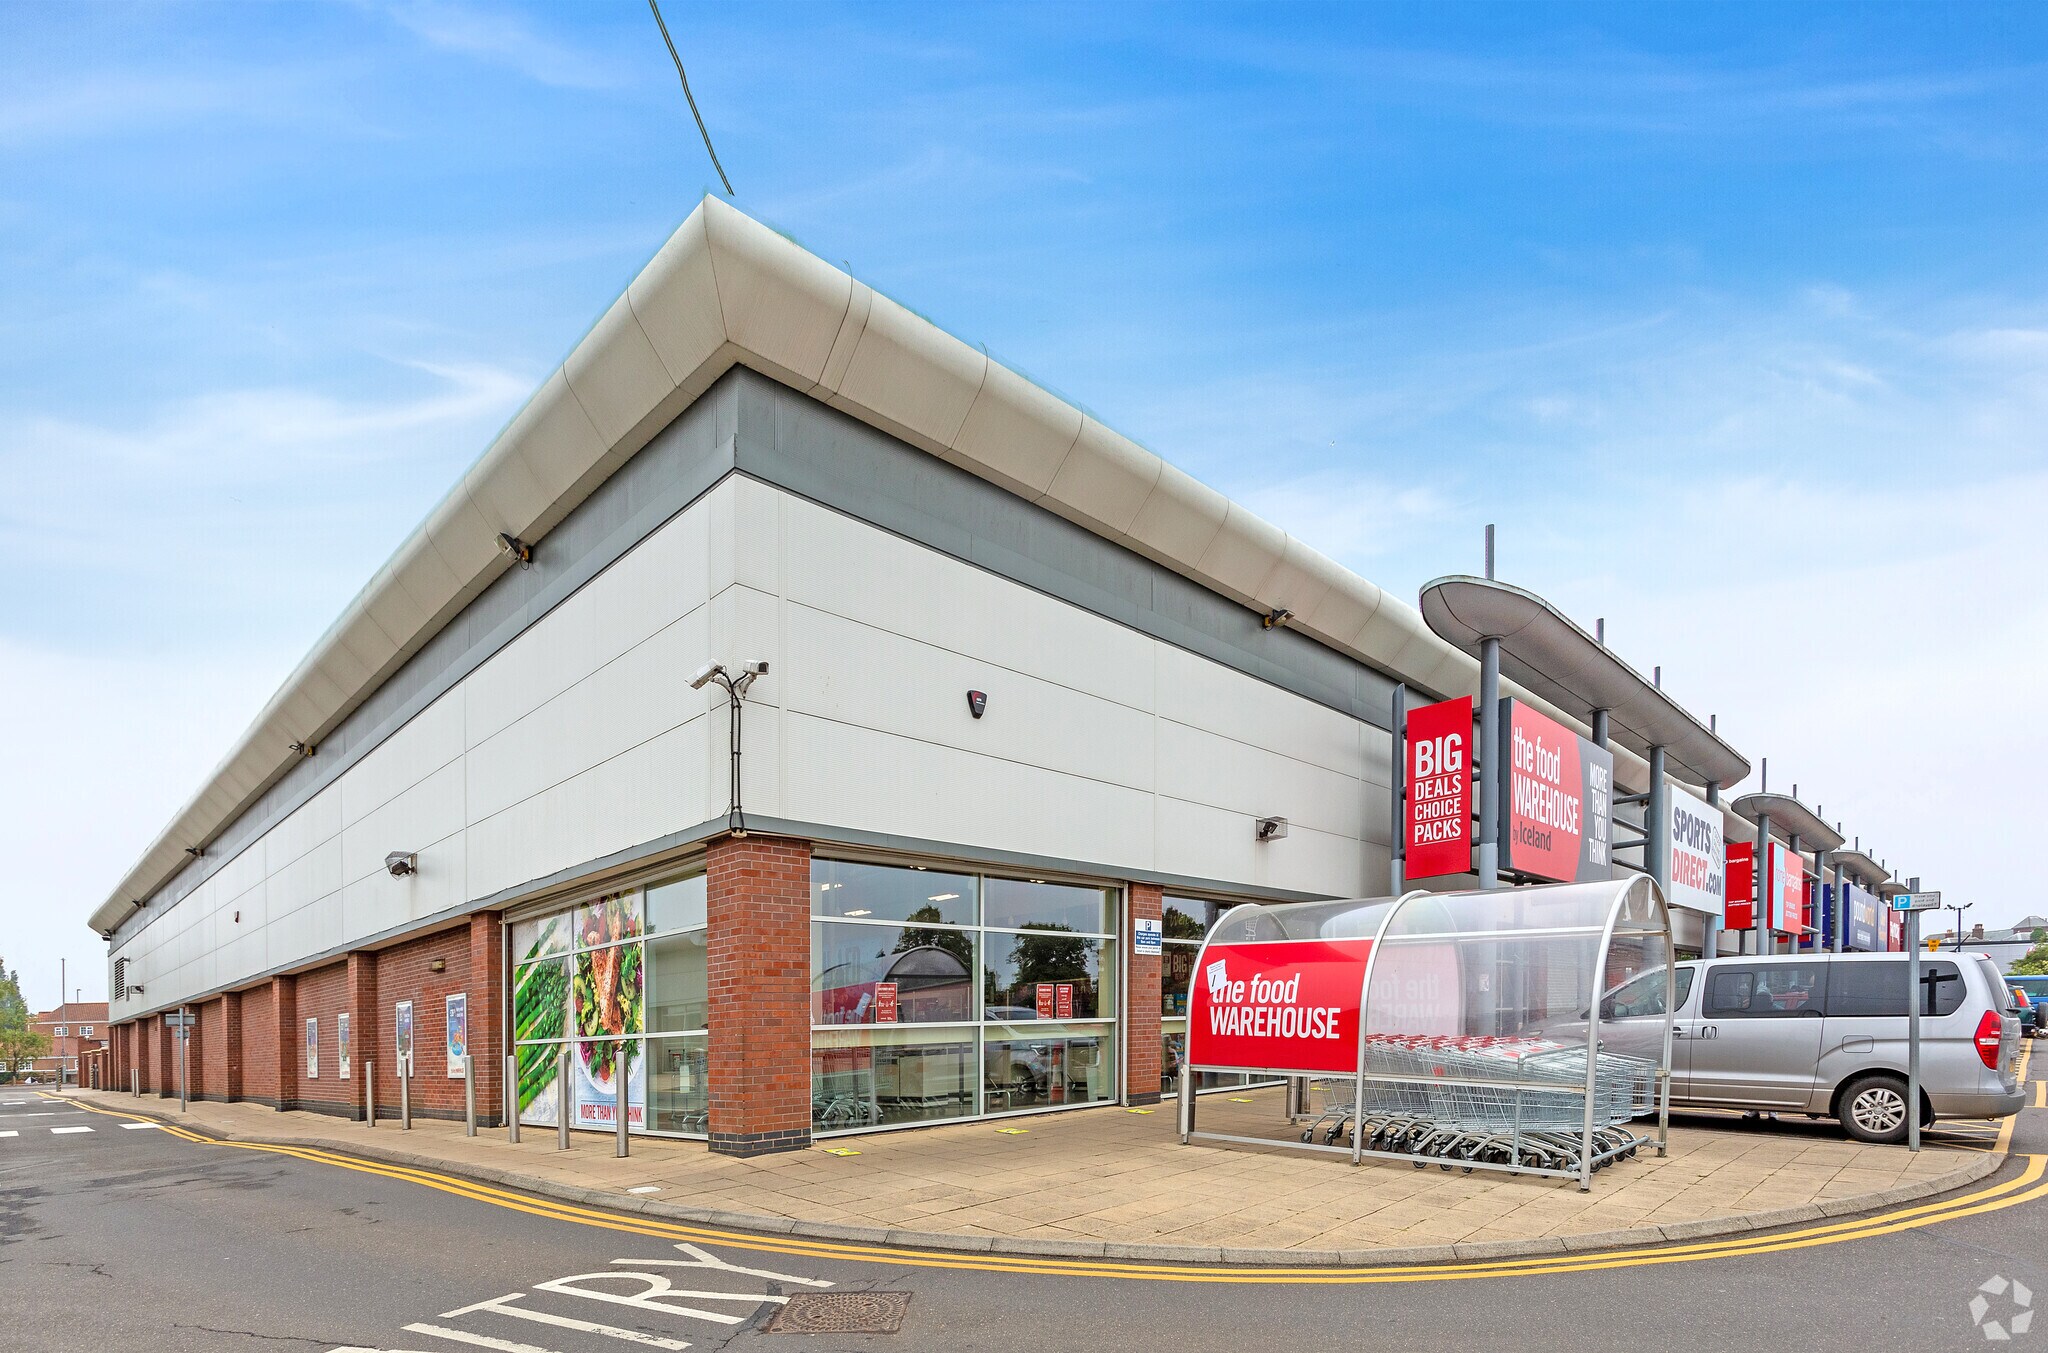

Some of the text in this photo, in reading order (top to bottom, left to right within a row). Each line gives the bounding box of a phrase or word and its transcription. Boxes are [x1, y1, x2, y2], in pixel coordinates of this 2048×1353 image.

[1415, 733, 1462, 778] BIG
[1514, 727, 1560, 785] the food
[1415, 775, 1461, 801] DEALS
[1590, 762, 1608, 792] MORE
[1415, 797, 1461, 820] CHOICE
[1513, 772, 1579, 836] WAREHOUSE
[1592, 789, 1607, 817] THAN
[1415, 818, 1461, 843] PACKS
[1512, 821, 1552, 851] by Iceland
[1594, 815, 1607, 841] YOU
[1673, 806, 1711, 854] SPORTS
[1589, 838, 1607, 866] THINK
[1672, 848, 1721, 896] DIRECT.COM
[1897, 897, 1908, 908] P
[1173, 954, 1187, 974] BIG
[1250, 973, 1300, 1003] food
[1210, 1006, 1341, 1039] WAREHOUSE
[581, 1104, 596, 1119] MORE
[597, 1105, 611, 1120] THAN
[627, 1106, 643, 1123] HINK
